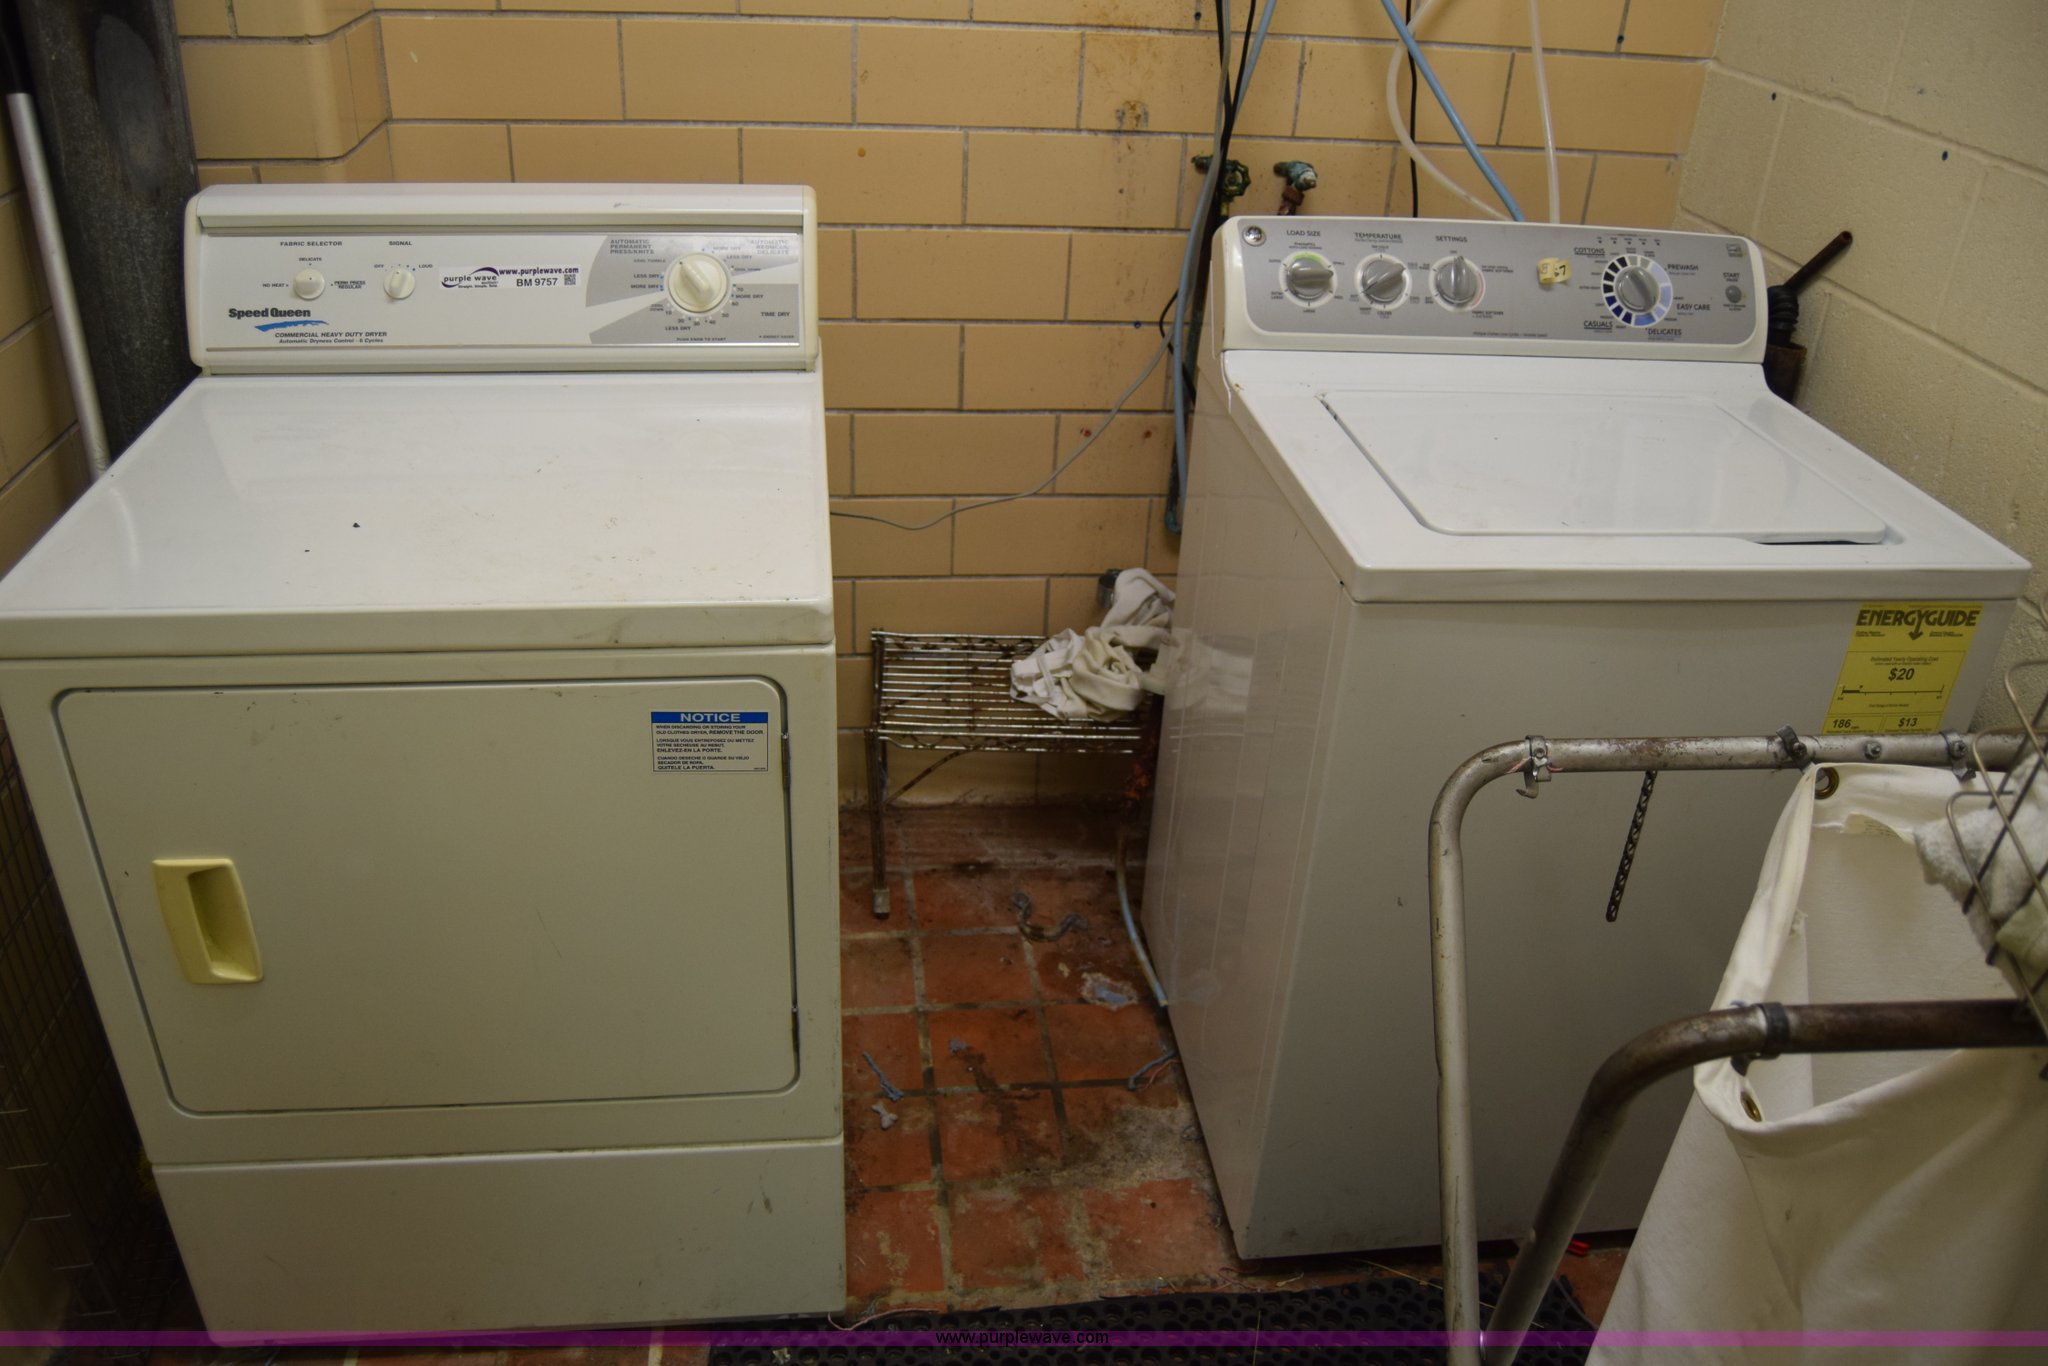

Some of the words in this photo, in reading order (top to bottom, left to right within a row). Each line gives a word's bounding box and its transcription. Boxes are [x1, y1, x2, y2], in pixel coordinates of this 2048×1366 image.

[1435, 235, 1468, 243] SETTINGS
[499, 267, 579, 276] www.purplewave.com
[516, 278, 532, 287] BM
[534, 278, 558, 287] 9757
[228, 308, 269, 319] Speed
[270, 307, 311, 318] Queen
[1855, 609, 1980, 627] ENERGYGUIDE
[1888, 668, 1915, 682] $20
[680, 713, 741, 722] NOTICE
[1898, 717, 1918, 727] $13
[1833, 719, 1851, 728] 186
